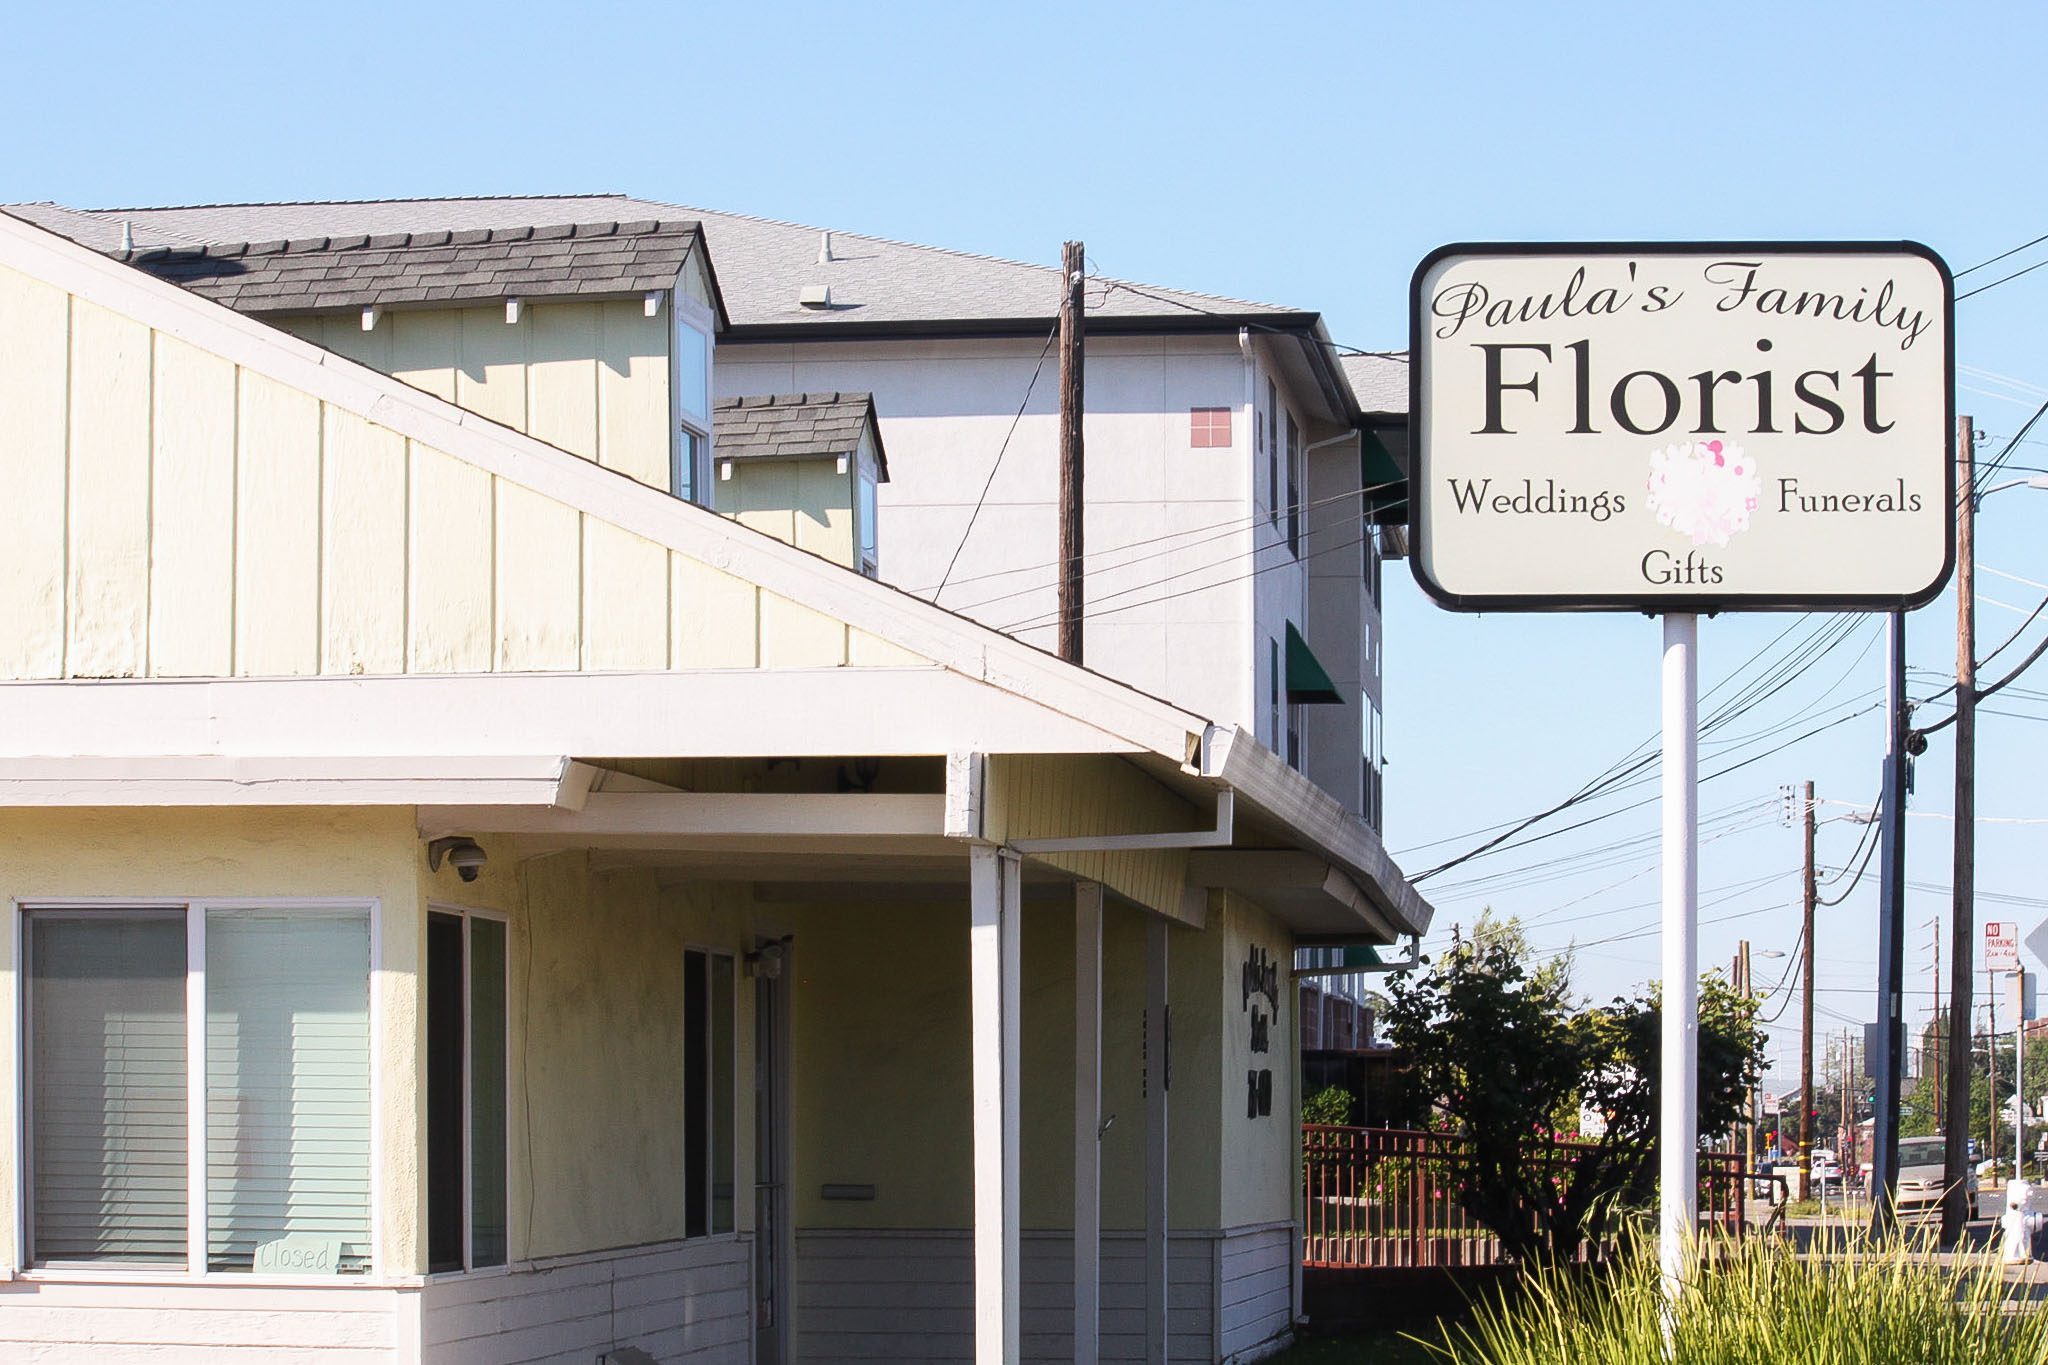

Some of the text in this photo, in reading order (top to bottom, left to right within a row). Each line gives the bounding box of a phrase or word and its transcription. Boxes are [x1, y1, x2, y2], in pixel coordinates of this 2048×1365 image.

[1431, 261, 1932, 351] Paula's Family
[1470, 338, 1897, 436] Florist
[1447, 478, 1626, 522] Weddings
[1777, 478, 1922, 514] Funerals
[1641, 549, 1723, 585] Gifts
[1987, 925, 1998, 935] NO
[1988, 939, 2014, 947] PARKING
[260, 1242, 330, 1270] Closed
